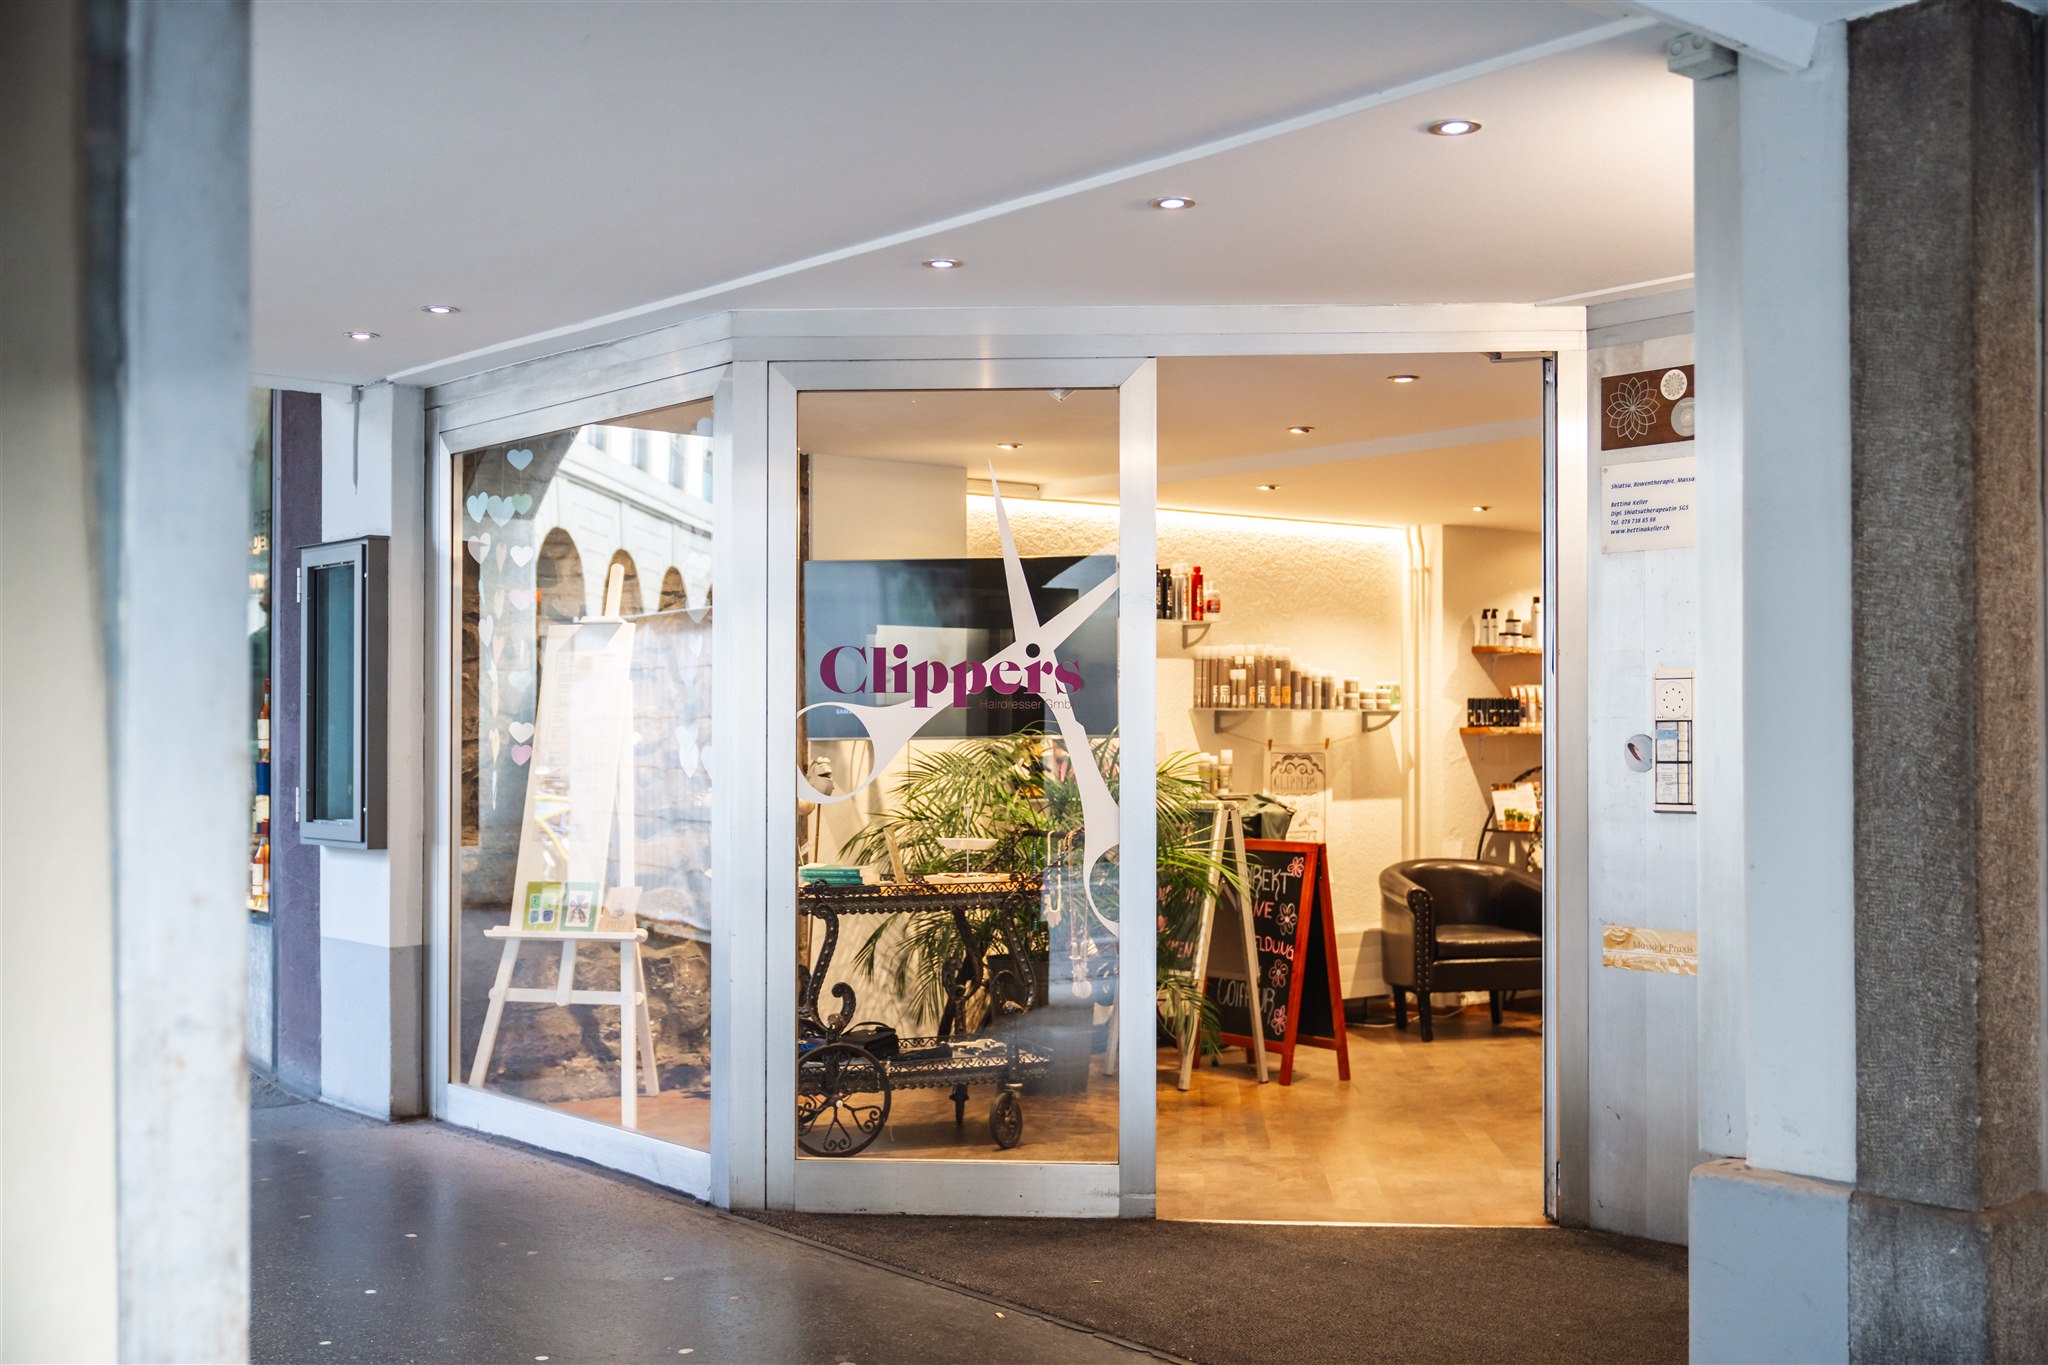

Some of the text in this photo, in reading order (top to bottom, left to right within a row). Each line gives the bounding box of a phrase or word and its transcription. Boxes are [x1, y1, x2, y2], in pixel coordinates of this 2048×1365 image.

[1624, 505, 1677, 515] Shiatsutherapeutin
[1610, 525, 1670, 534] www.bettinakeller.ch
[819, 643, 1084, 709] Clippers
[979, 698, 1042, 710] Hairdresser
[1668, 943, 1694, 954] Praxis
